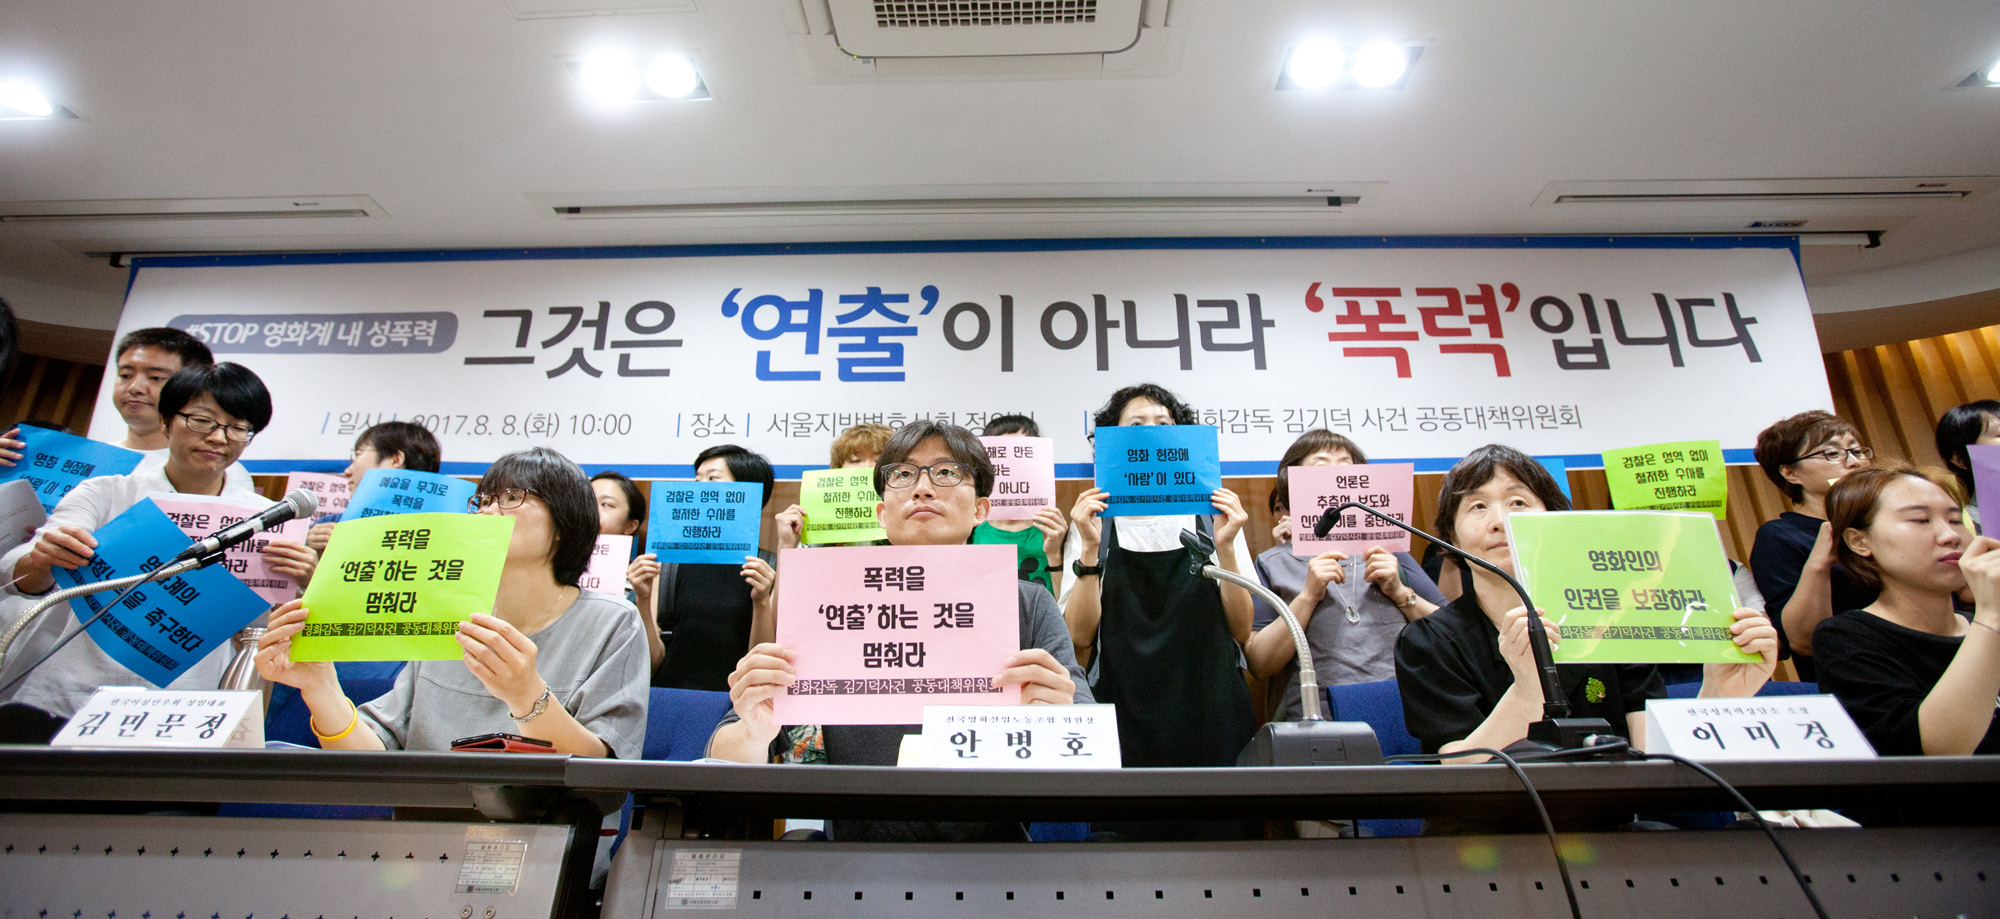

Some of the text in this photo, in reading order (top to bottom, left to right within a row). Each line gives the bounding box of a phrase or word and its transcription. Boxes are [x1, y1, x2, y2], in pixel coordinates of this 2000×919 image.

[263, 321, 334, 347] 영화계
[337, 321, 363, 346] 내
[366, 319, 438, 346] 성폭력
[463, 300, 683, 380] 그것은
[1040, 293, 1275, 372] 아니라
[570, 413, 632, 436] 10:00
[690, 412, 736, 437] 장소
[1193, 408, 1274, 434] 화감독
[1283, 406, 1352, 433] 김기덕
[1361, 406, 1408, 433] 사건
[1416, 404, 1583, 433] 공동대책위원회
[985, 446, 1033, 458] 해로 만든
[1127, 448, 1189, 462] 영화 현장에
[1622, 449, 1709, 469] 검찰은 성역 없이
[34, 452, 96, 477] 영화 현장에
[993, 464, 1010, 476] 화는
[817, 476, 868, 488] 검찰은 성역
[1174, 471, 1196, 485] 있다
[1336, 475, 1369, 489] 언론은
[1635, 467, 1705, 484] 철저한 수사를
[416, 480, 448, 496] 무기로
[999, 481, 1030, 494] 아니다
[1654, 485, 1697, 499] 진행하라
[392, 494, 424, 510] 폭력을
[666, 490, 745, 504] 검찰은 성역 없이
[823, 491, 851, 503] 철저한
[672, 508, 736, 521] 철저한 수사를
[835, 507, 872, 519] 진행하라
[381, 528, 431, 550] 폭력을
[682, 526, 721, 538] 진행하라
[1588, 550, 1663, 572] 영화인의
[428, 559, 464, 581] 것을
[139, 555, 200, 606] 영계의
[864, 566, 925, 592] 폭력을
[366, 592, 418, 614] 멈춰라
[1564, 588, 1708, 611] 인권을 보장하라
[933, 602, 975, 629] 것을
[145, 607, 204, 652] 촉구한다
[304, 623, 343, 636] 영화감독
[402, 621, 461, 635] 공동대책위원
[1556, 626, 1595, 640] 화감독
[863, 642, 926, 668] 멈춰라
[843, 679, 906, 695] 김기덕사건
